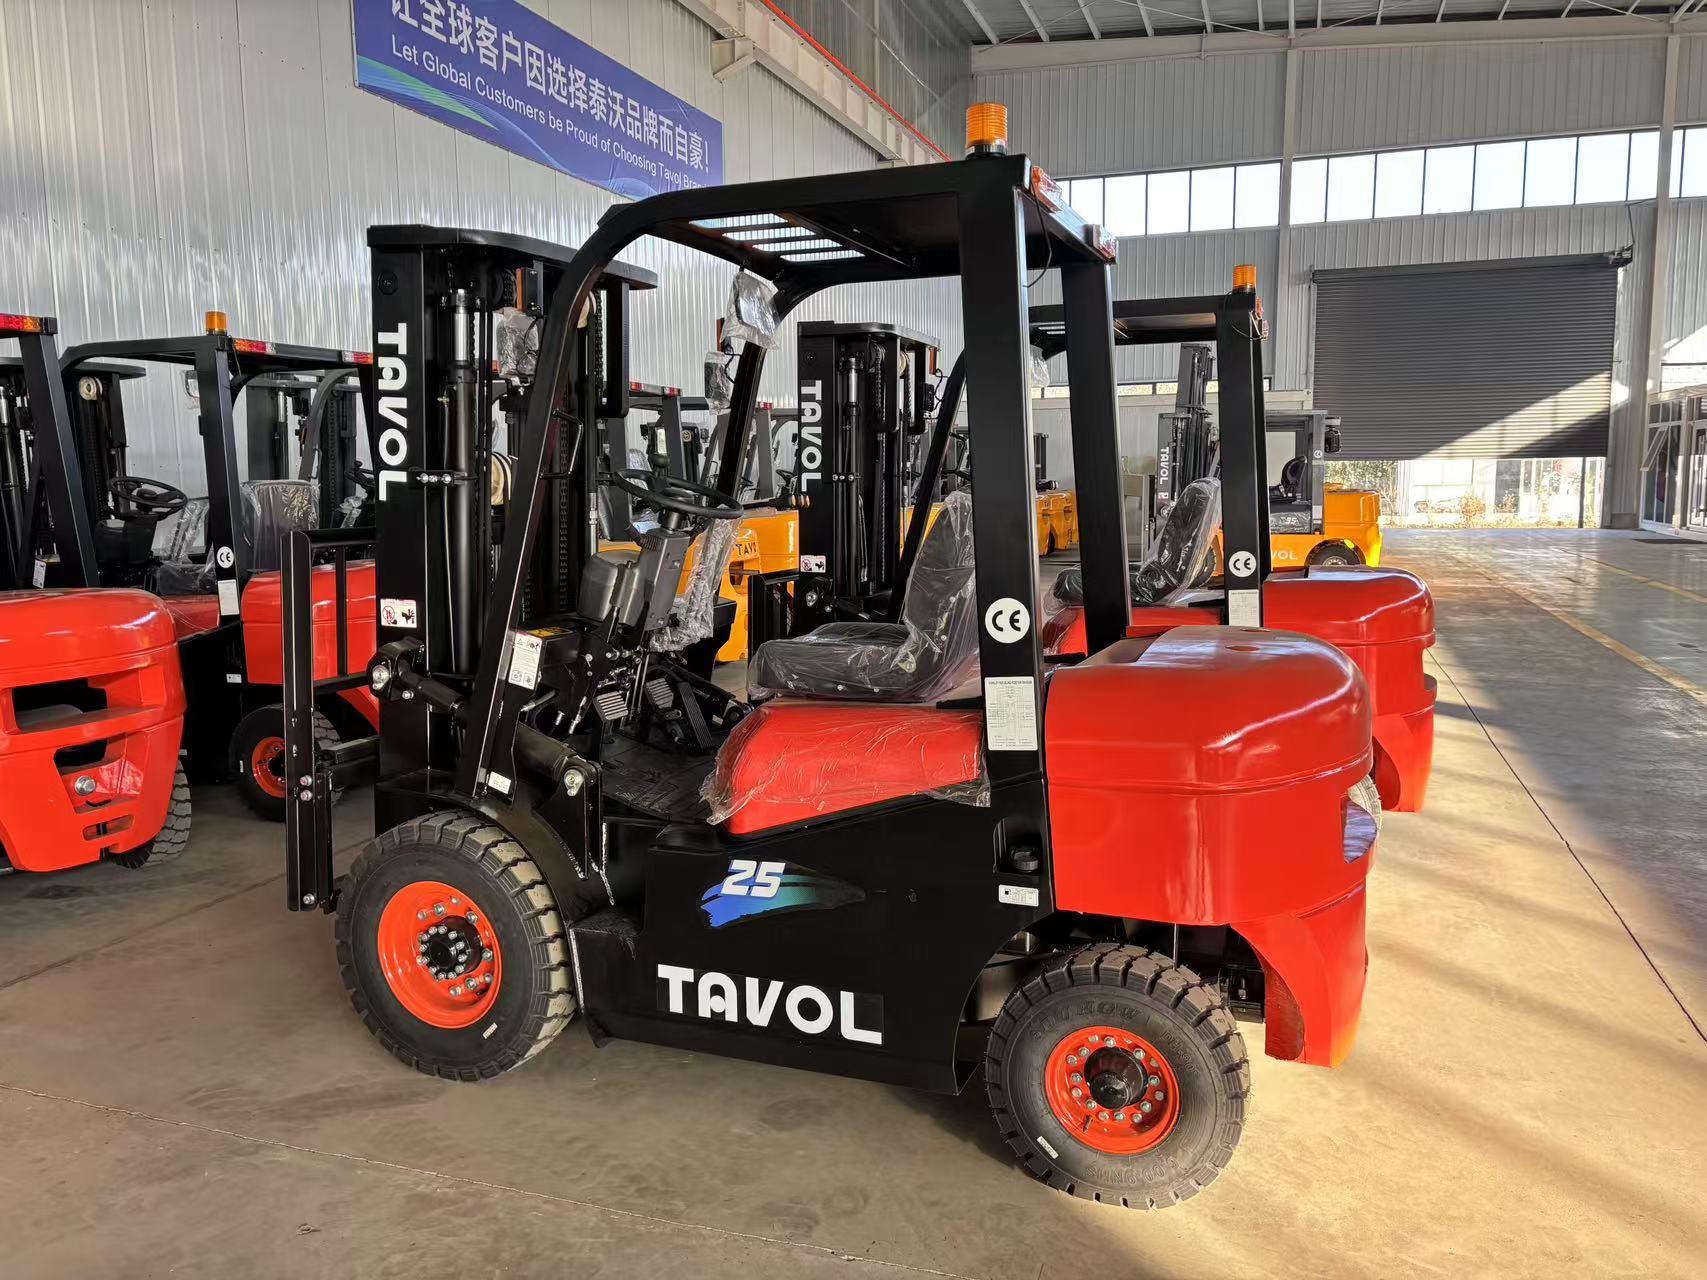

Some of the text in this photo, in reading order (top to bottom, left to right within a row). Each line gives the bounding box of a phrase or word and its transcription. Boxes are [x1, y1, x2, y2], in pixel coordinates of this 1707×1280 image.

[392, 34, 418, 66] Let
[422, 51, 471, 90] Global
[475, 77, 545, 124] Customers
[549, 111, 563, 132] be
[566, 119, 598, 147] Proud
[600, 138, 611, 154] of
[613, 142, 657, 177] Choosing
[658, 162, 682, 189] Tavol
[378, 323, 407, 501] TAVOL
[801, 380, 822, 492] TAVOL
[1160, 447, 1169, 484] TAVOL
[1233, 557, 1251, 571] CE
[992, 609, 1021, 632] CE
[720, 859, 786, 898] 25
[657, 963, 882, 1045] TAVOL
